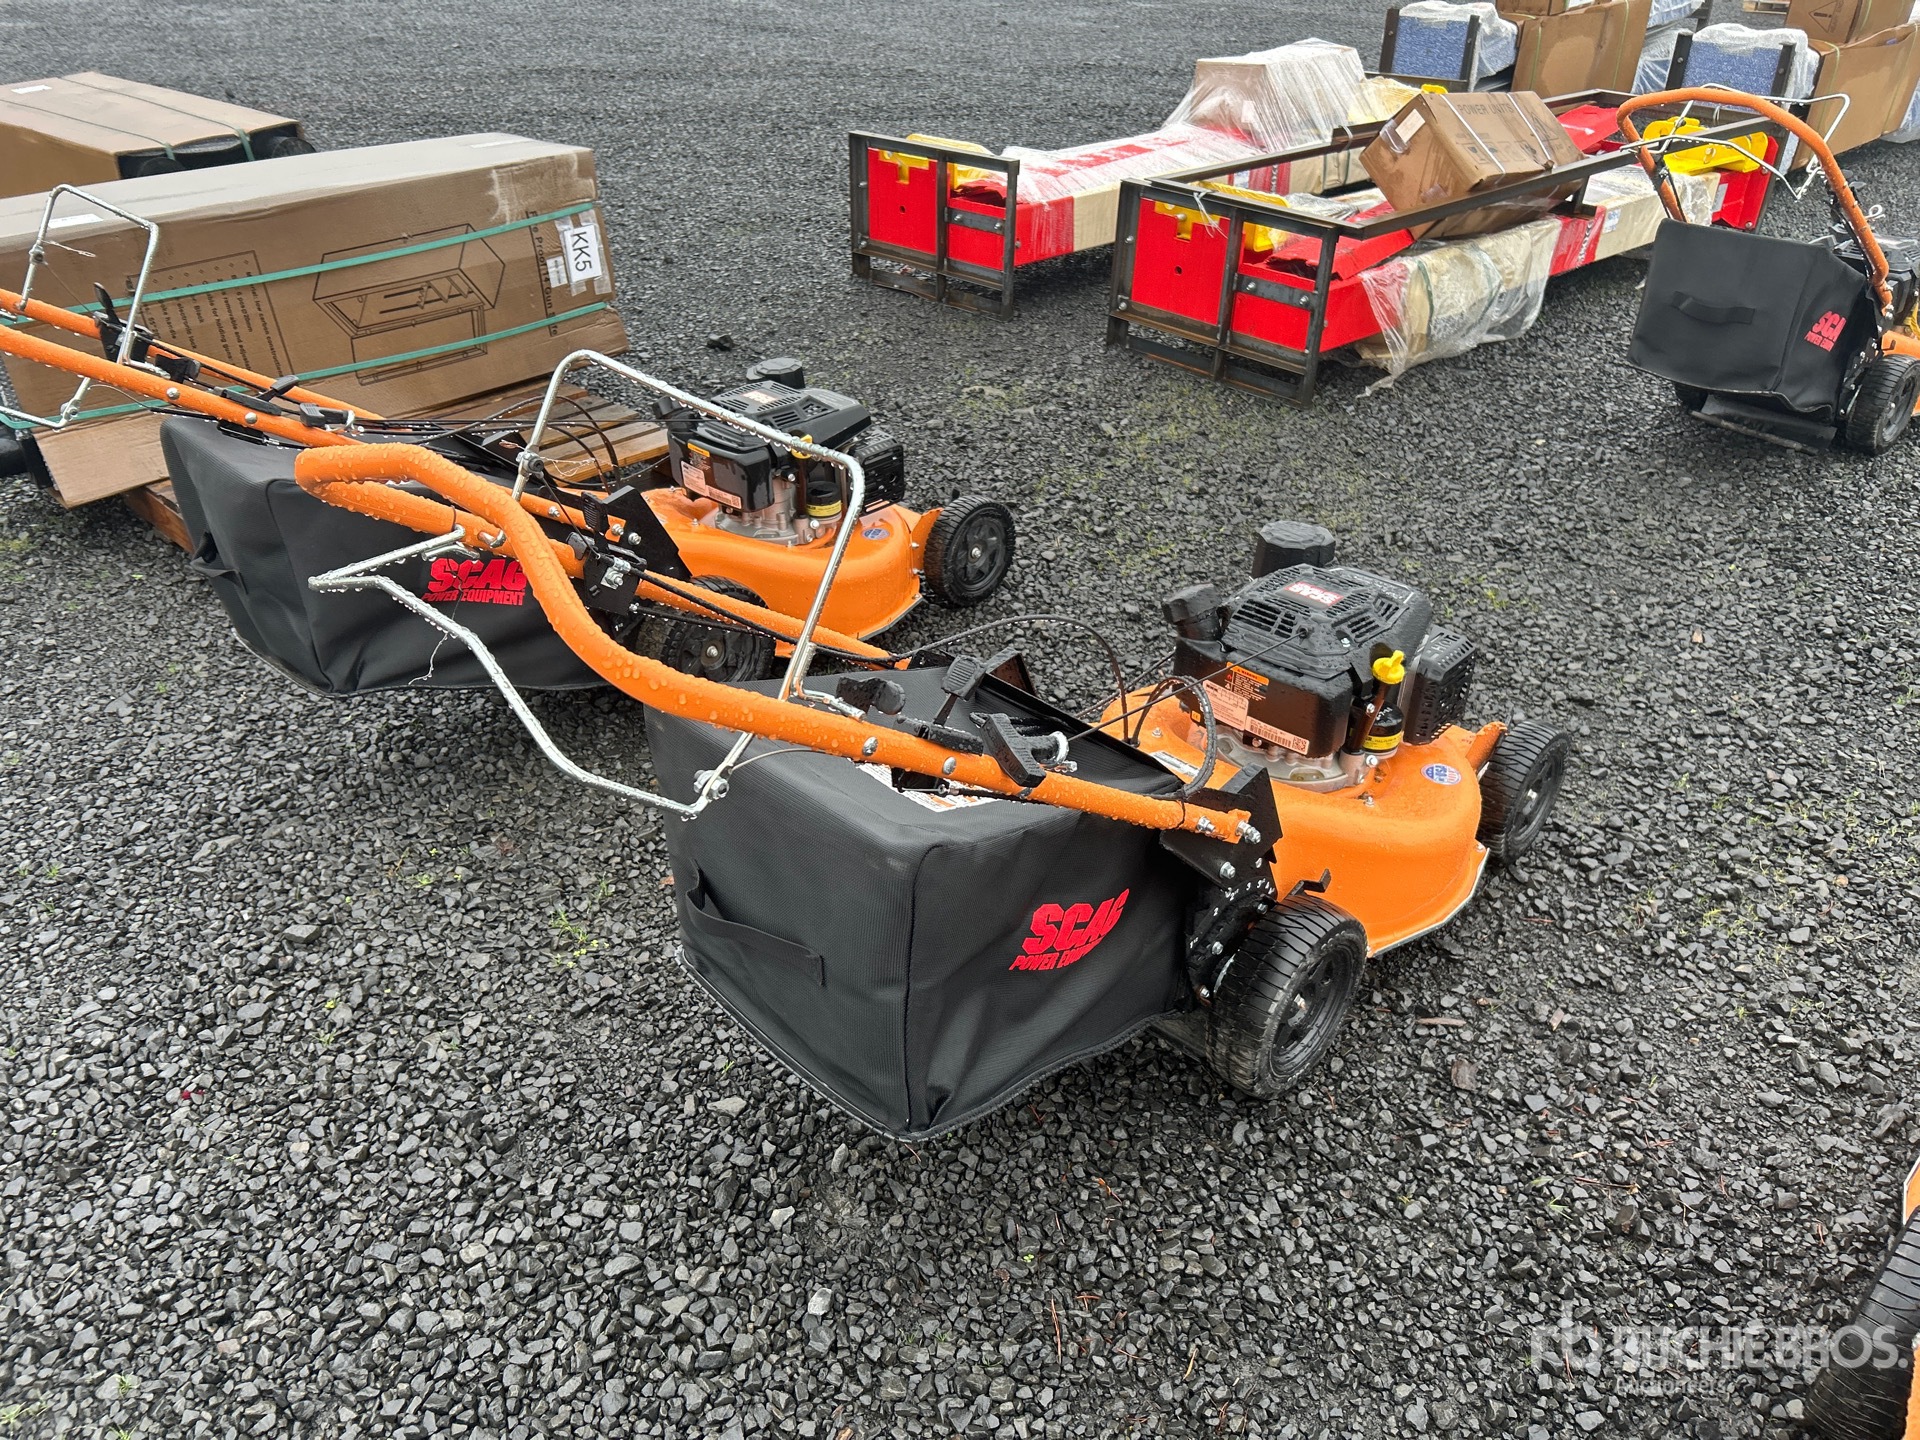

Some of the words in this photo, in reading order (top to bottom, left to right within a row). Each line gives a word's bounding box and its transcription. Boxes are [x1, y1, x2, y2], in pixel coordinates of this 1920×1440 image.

[1457, 104, 1488, 115] POWER
[1488, 103, 1514, 114] UNITS
[528, 210, 539, 233] Fre
[535, 236, 548, 267] Proof
[571, 231, 593, 272] KK5
[541, 270, 551, 283] 14
[544, 286, 554, 309] Gun
[194, 305, 204, 324] Black
[223, 297, 239, 330] removable
[234, 331, 243, 344] and
[259, 313, 270, 336] carbon
[547, 312, 558, 336] Sfe
[177, 303, 192, 336] electronic
[188, 335, 198, 350] lock
[215, 319, 228, 344] holding
[428, 557, 529, 592] SCAG
[421, 590, 459, 602] POWER
[461, 589, 526, 606] EQUIPMENT
[1021, 888, 1130, 955] SCAG
[1009, 952, 1060, 971] POWER
